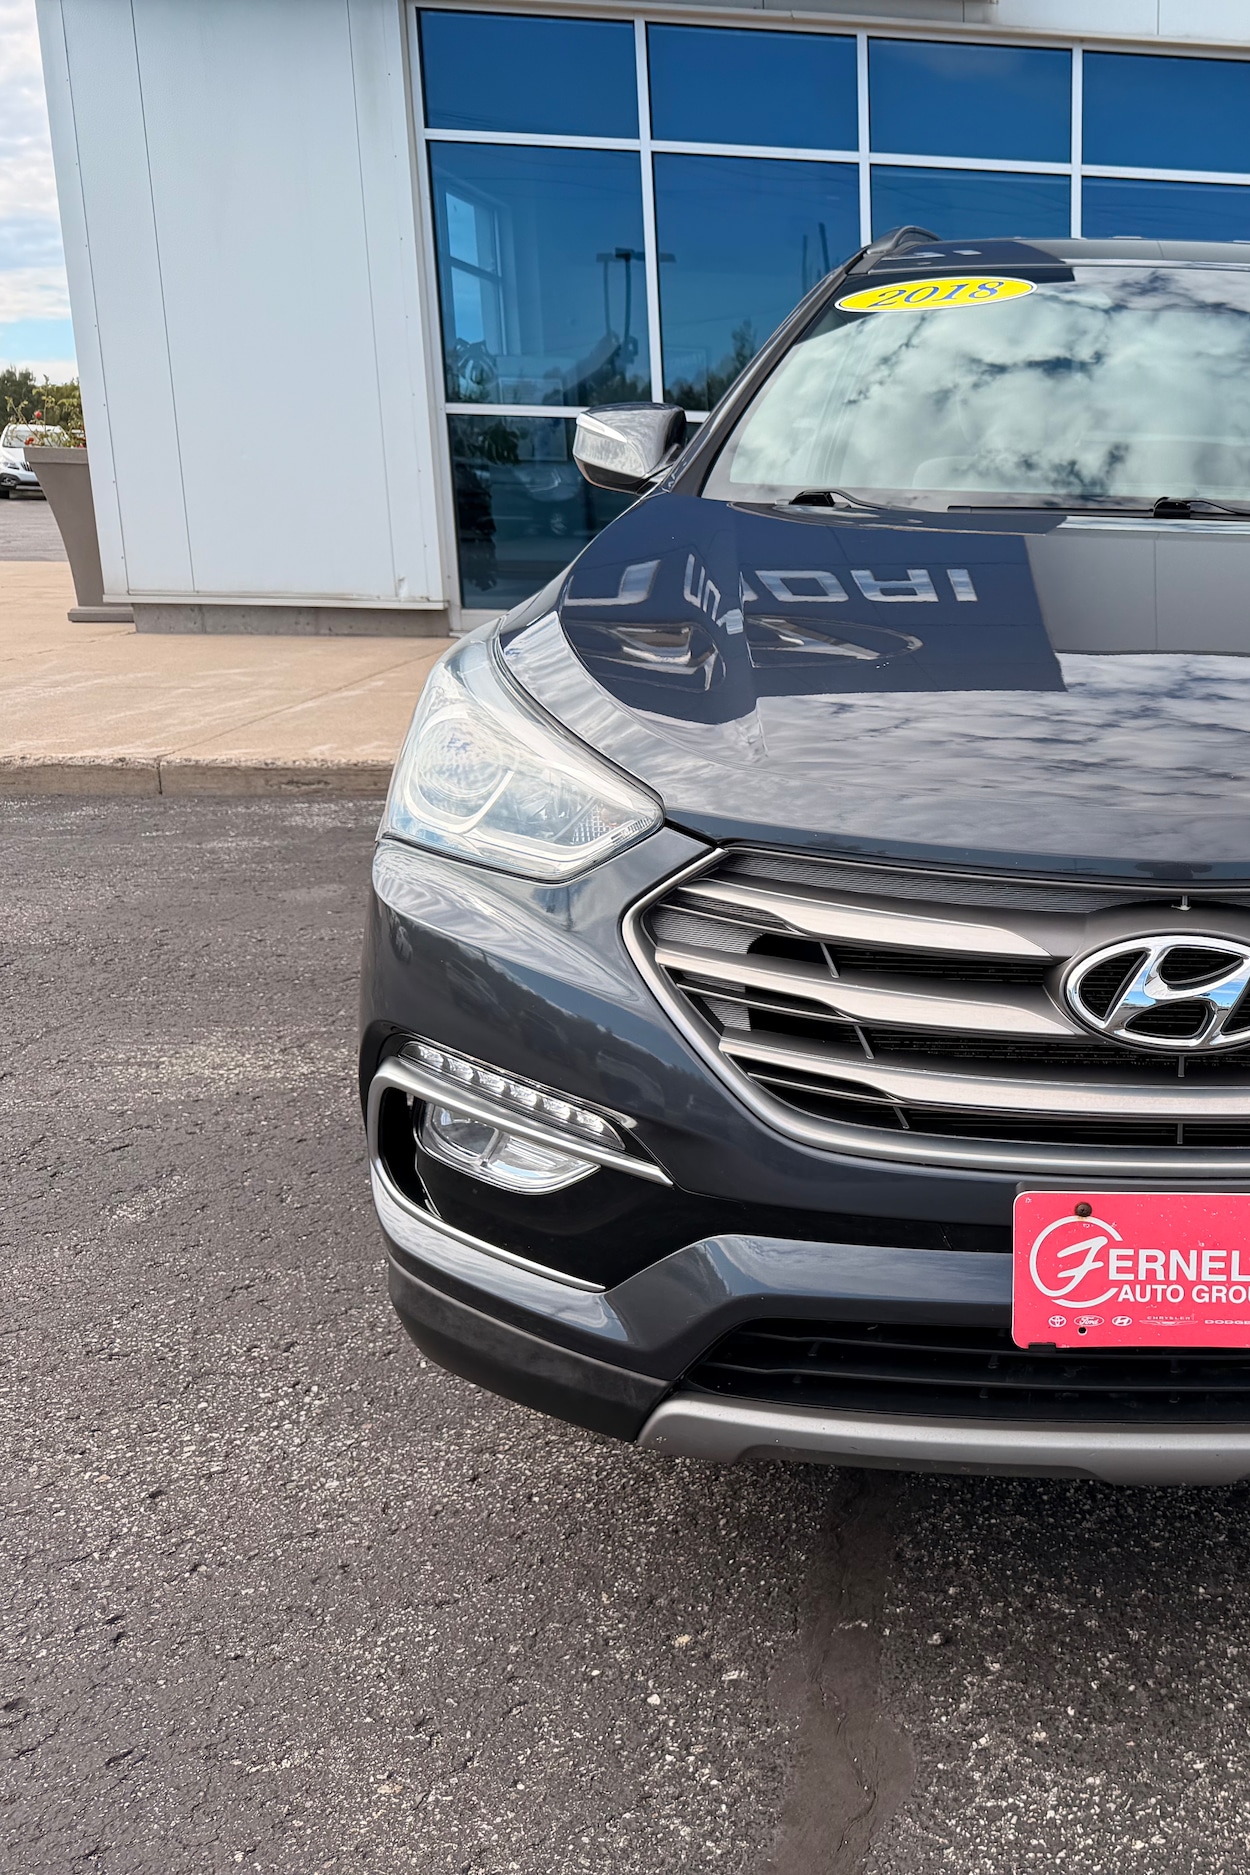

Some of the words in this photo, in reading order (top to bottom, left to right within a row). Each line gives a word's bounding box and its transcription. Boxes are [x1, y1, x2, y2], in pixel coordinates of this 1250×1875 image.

[867, 281, 1005, 309] 2018
[1117, 1284, 1185, 1303] AUTO
[1078, 1315, 1101, 1326] Ford
